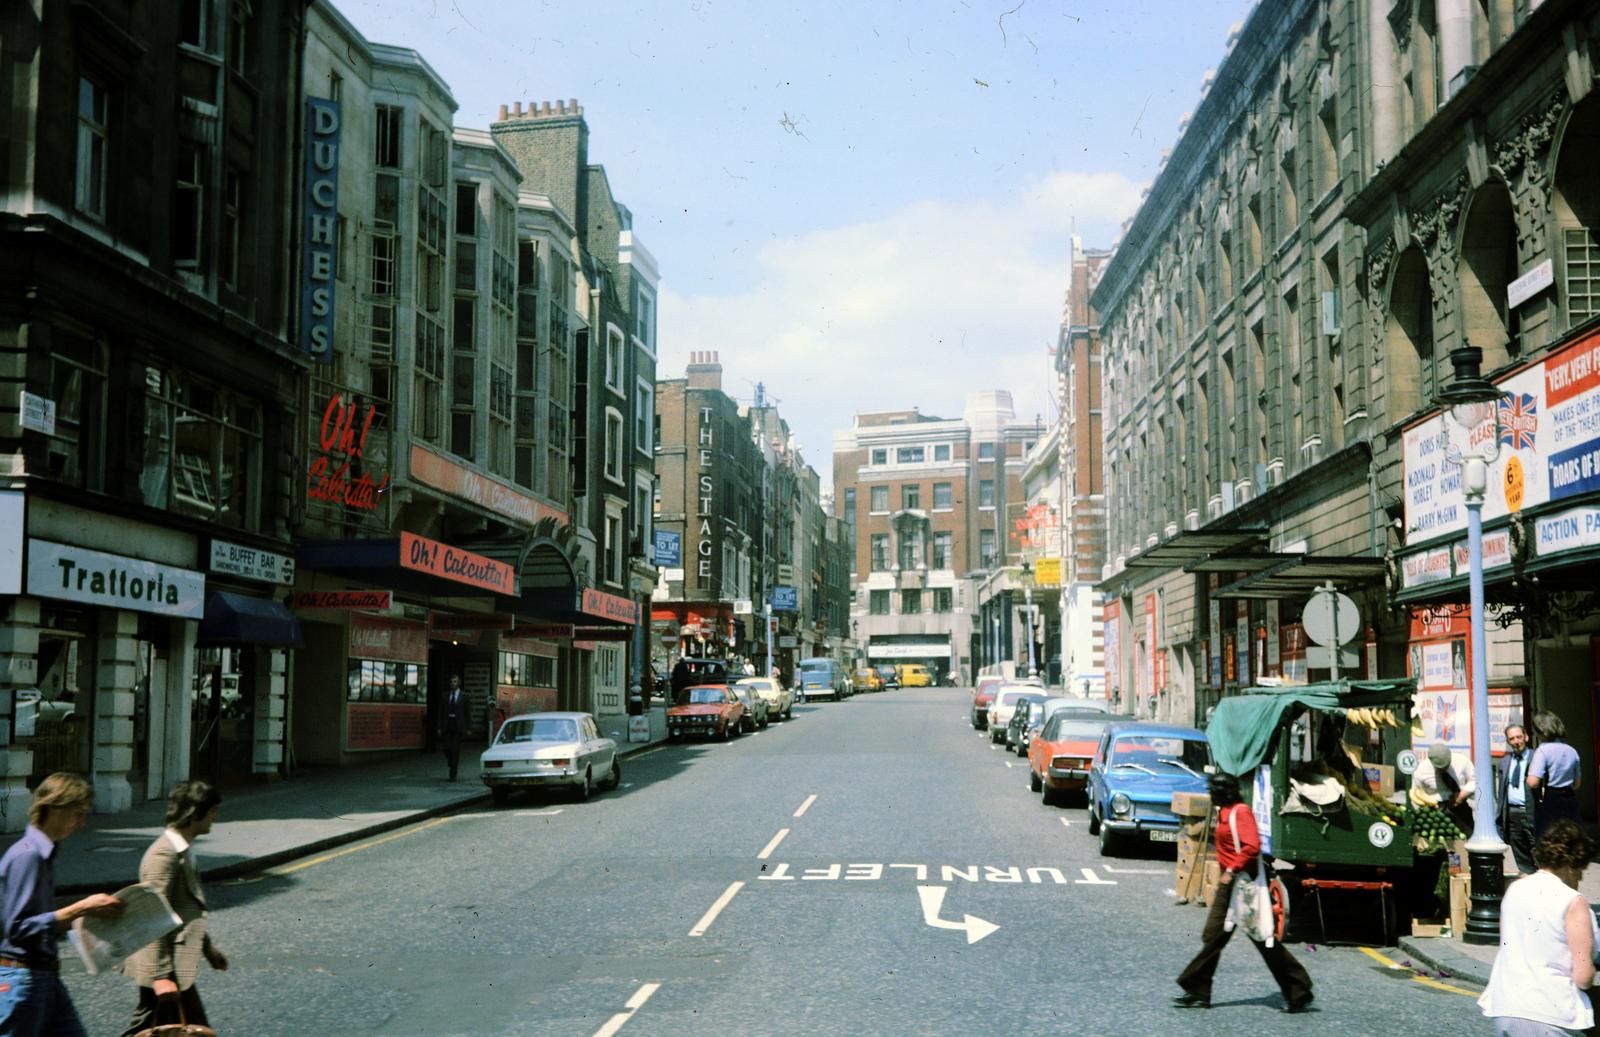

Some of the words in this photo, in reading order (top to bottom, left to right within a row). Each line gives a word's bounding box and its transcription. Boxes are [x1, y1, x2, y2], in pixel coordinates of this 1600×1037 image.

[311, 104, 339, 353] DUCHESS
[1553, 406, 1575, 424] MAKES
[1576, 398, 1590, 416] ONE
[321, 394, 376, 457] Oh!
[699, 407, 713, 467] THE
[1469, 424, 1495, 448] PLEASE
[1554, 429, 1563, 442] OF
[1565, 422, 1576, 438] THE
[1581, 453, 1593, 479] OF
[698, 477, 713, 577] STAGE
[229, 546, 257, 565] BUFFET
[260, 554, 276, 570] BAR
[656, 540, 666, 550] TO
[668, 541, 679, 551] LET
[410, 539, 438, 569] Oh!
[443, 549, 509, 593] Calcutta!
[58, 558, 179, 605] Trattoria
[775, 592, 785, 600] TO
[786, 592, 796, 601] LET
[757, 863, 927, 880] LEFT
[943, 864, 1118, 885] TURN
